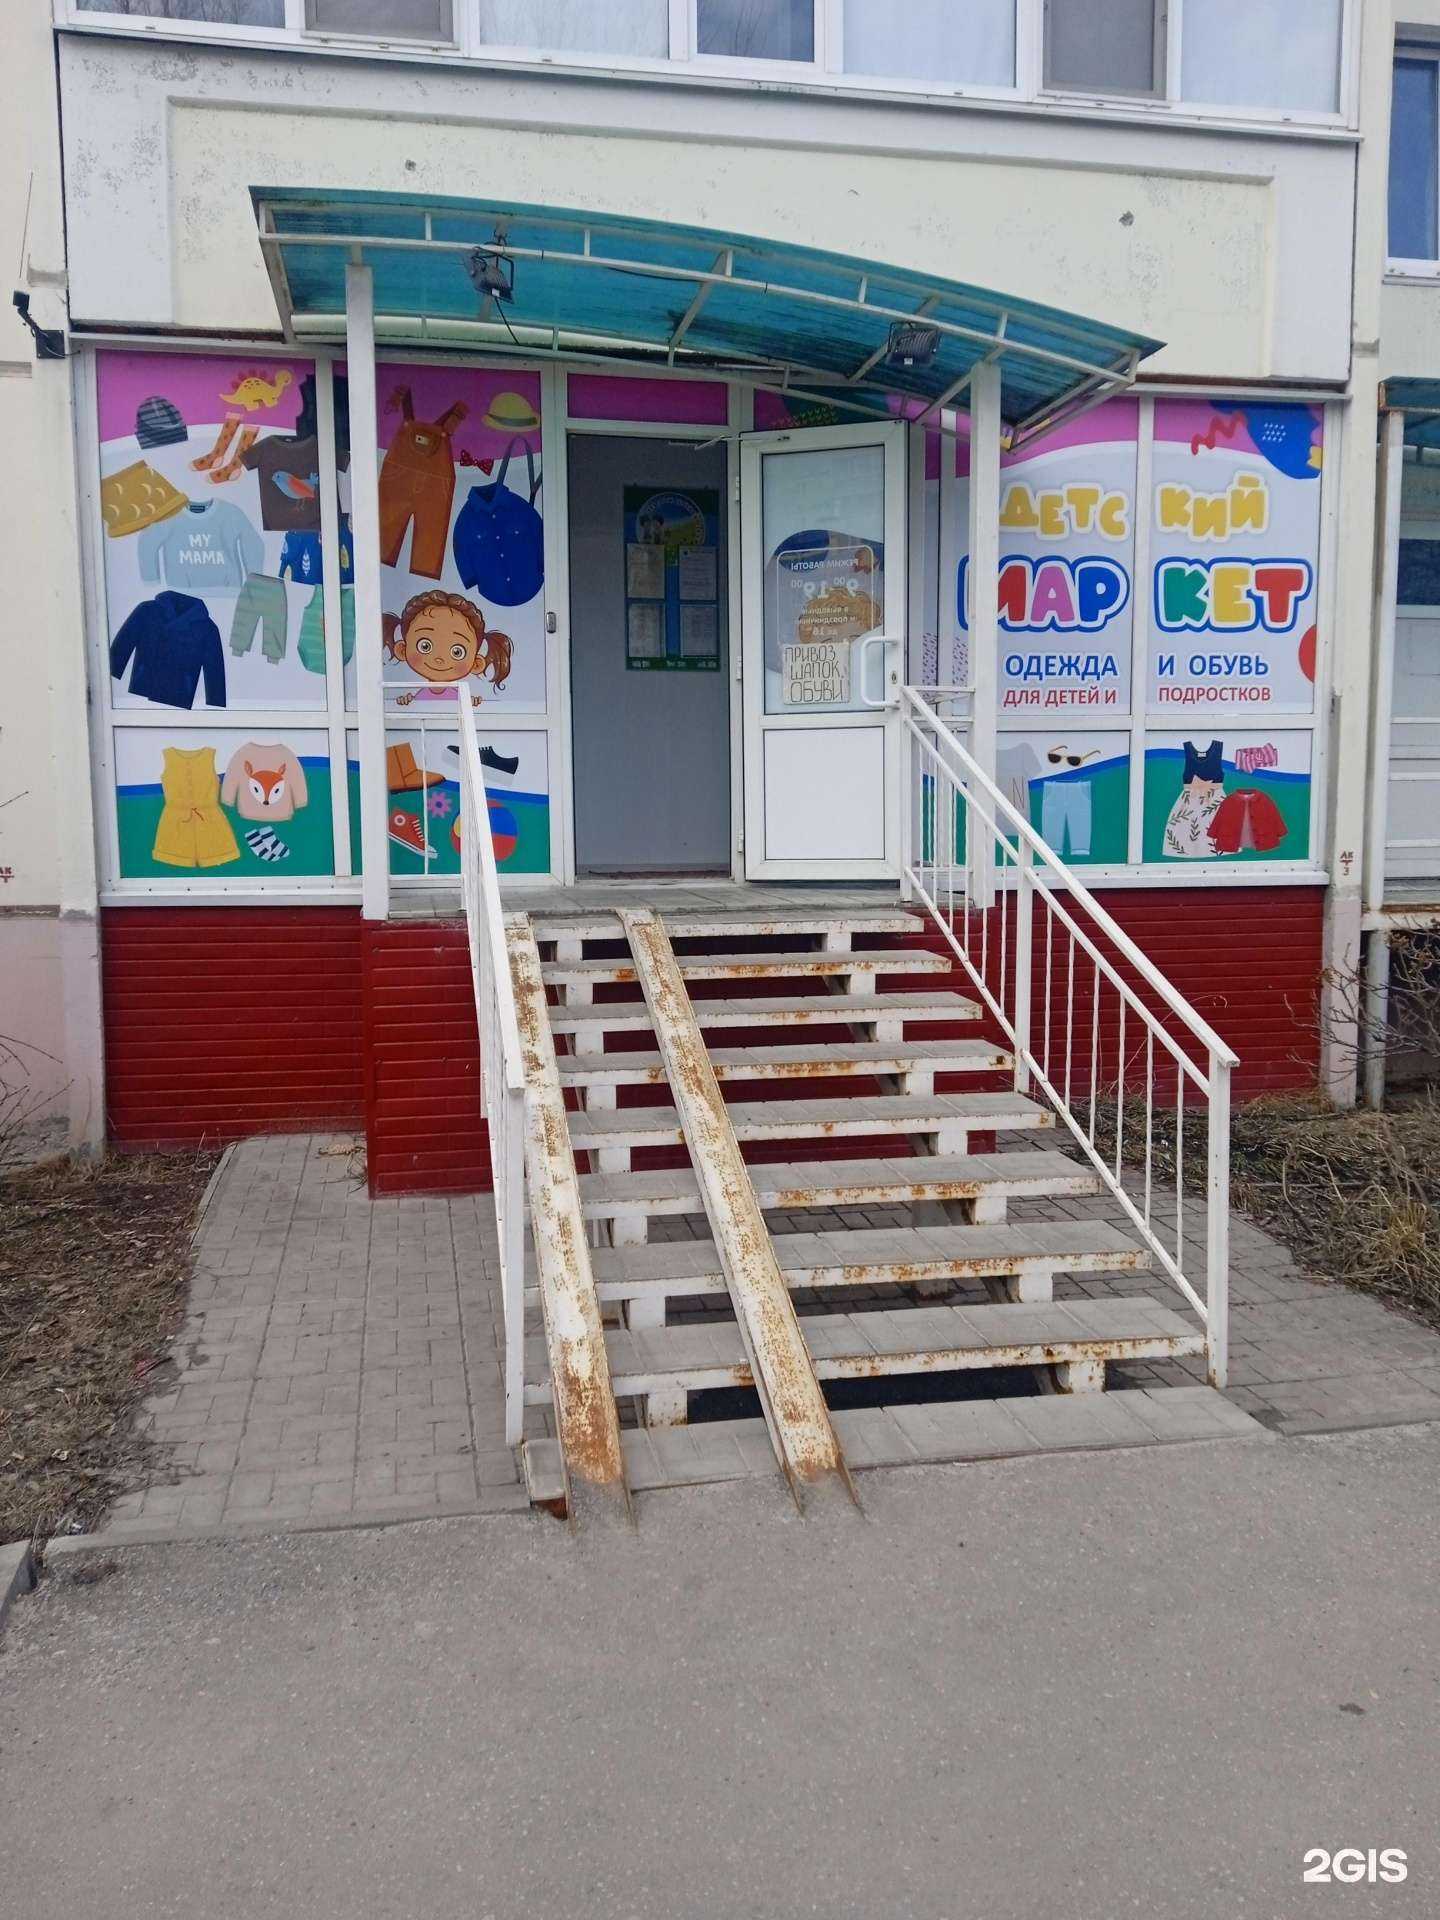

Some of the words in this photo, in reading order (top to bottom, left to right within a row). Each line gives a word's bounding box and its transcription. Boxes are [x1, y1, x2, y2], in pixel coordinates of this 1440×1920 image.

[188, 534, 211, 548] MY
[179, 550, 225, 565] MAMA
[785, 645, 836, 662] ПРИВОЗ
[1005, 655, 1119, 681] ОДЕЖДА
[1158, 655, 1175, 676] И
[1189, 655, 1269, 676] ОБУВЬ
[790, 680, 843, 702] ОБУВИ
[1003, 689, 1041, 708] ДЛЯ
[1045, 685, 1099, 708] ДЕТЕЙ
[1105, 689, 1116, 705] И
[1159, 687, 1271, 705] ПОДРОСТКОВ
